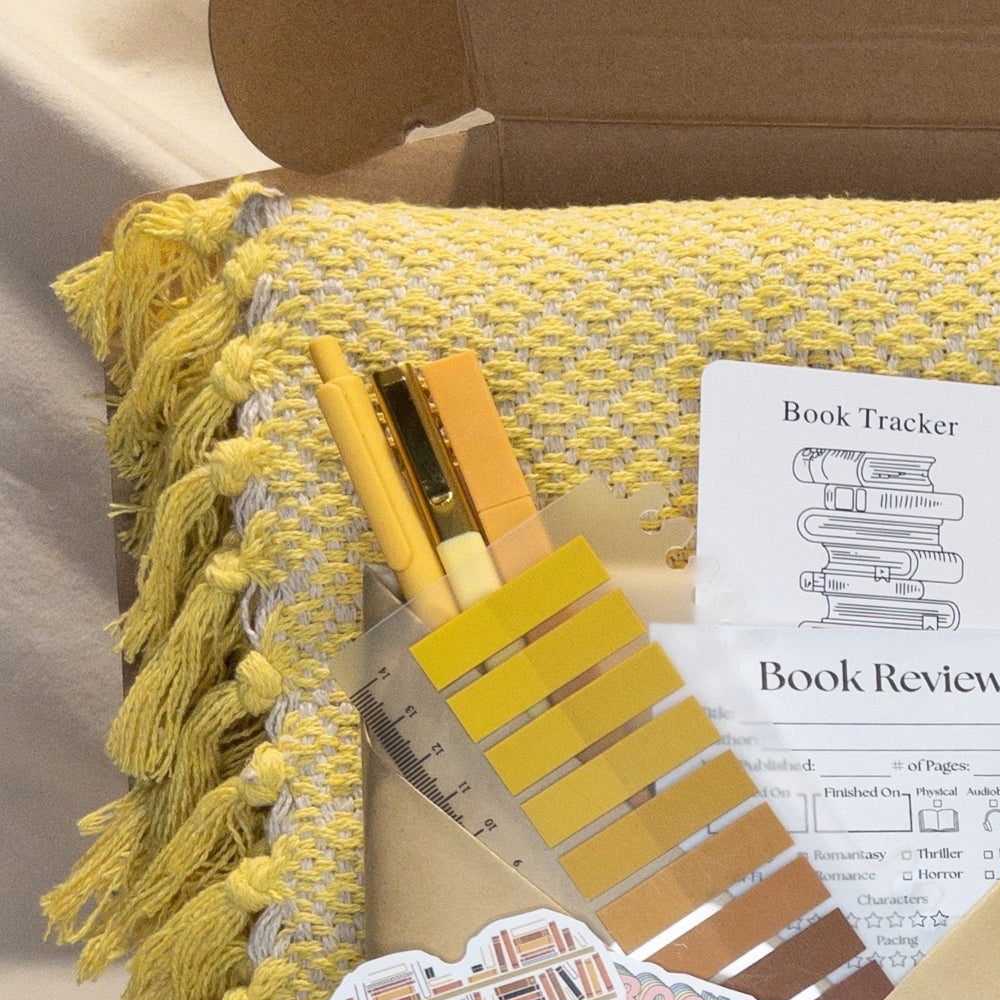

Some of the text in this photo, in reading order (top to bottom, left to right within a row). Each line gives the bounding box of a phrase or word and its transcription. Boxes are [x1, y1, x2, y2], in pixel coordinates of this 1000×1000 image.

[782, 400, 960, 437] Book Tracker
[759, 659, 866, 693] Book
[907, 758, 925, 772] of
[926, 758, 971, 775] Pages:
[824, 786, 902, 799] Finished On
[916, 787, 958, 799] Physical
[813, 849, 887, 862] Romantasy
[917, 848, 964, 860] Thriller
[918, 868, 964, 880] Horror
[857, 893, 929, 906] Characters
[876, 935, 920, 949] Pacing
